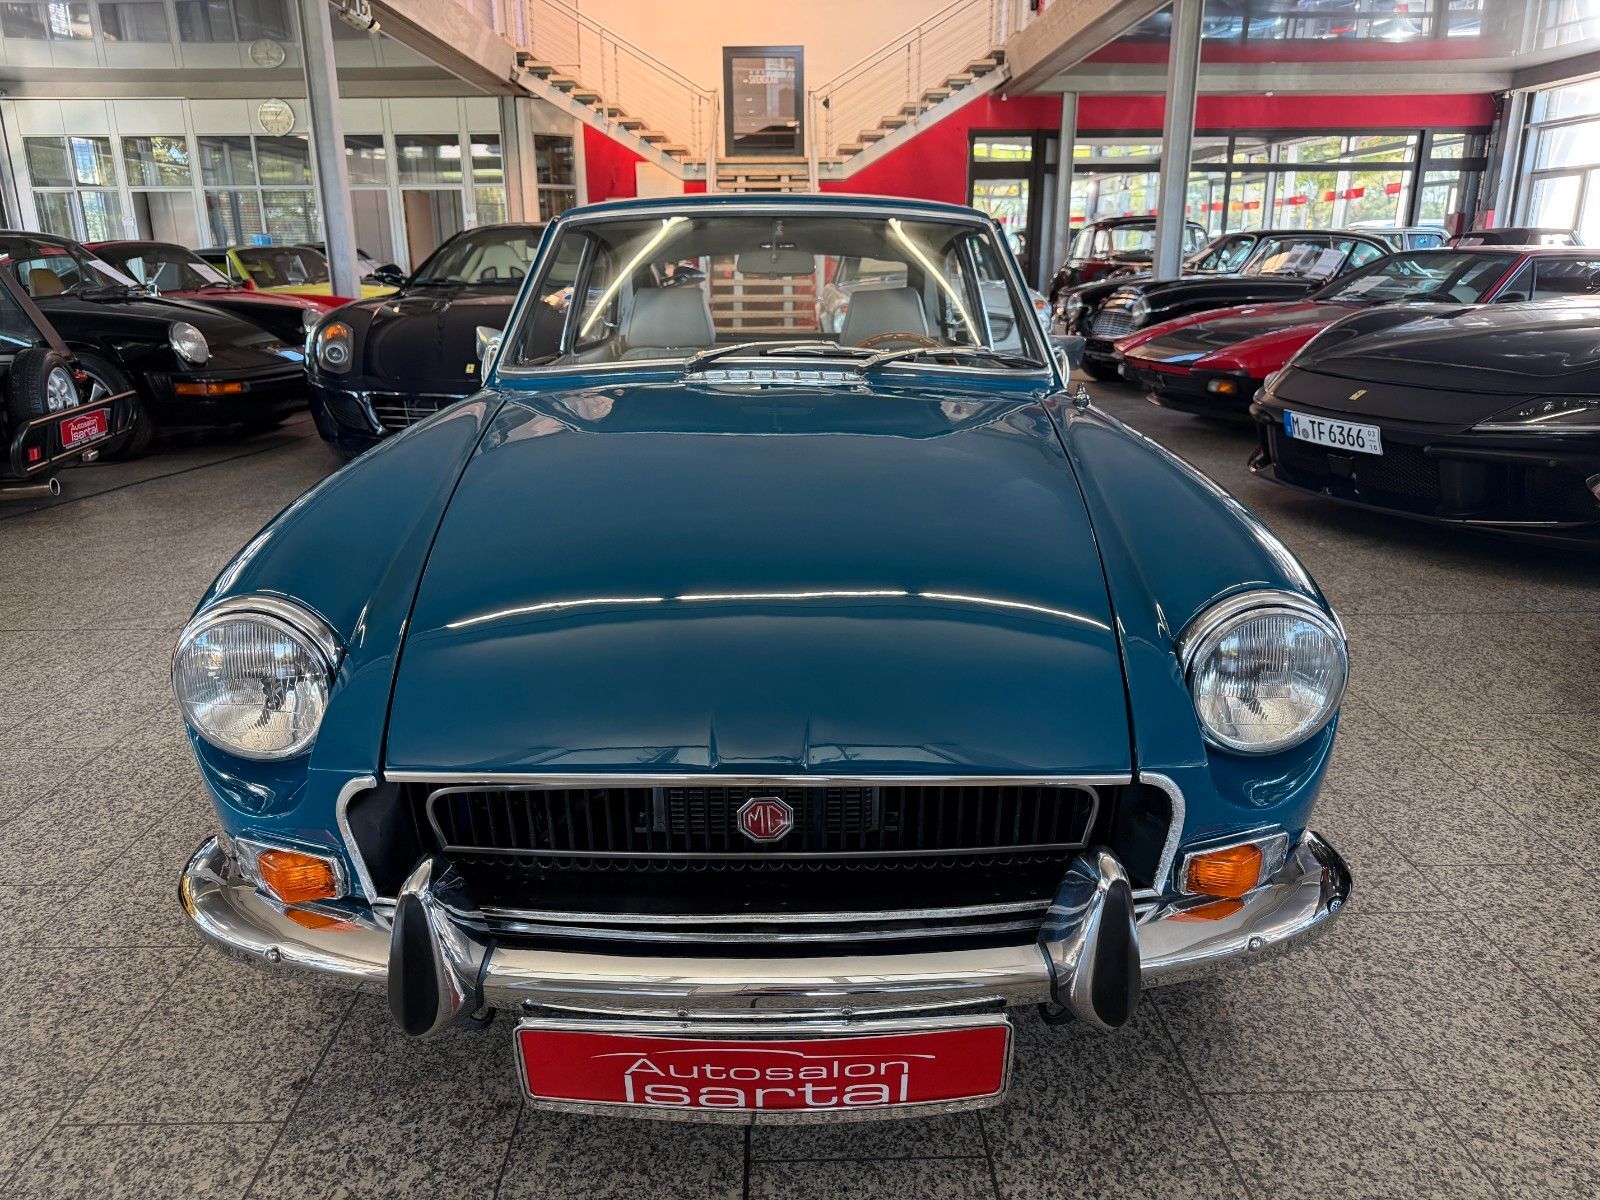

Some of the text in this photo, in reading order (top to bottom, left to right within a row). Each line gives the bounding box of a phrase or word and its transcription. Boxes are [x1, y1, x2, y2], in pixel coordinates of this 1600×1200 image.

[1291, 416, 1365, 449] M TF 6366
[747, 805, 787, 834] MG
[624, 1057, 909, 1081] Autosalon
[623, 1073, 909, 1109] Isartal
